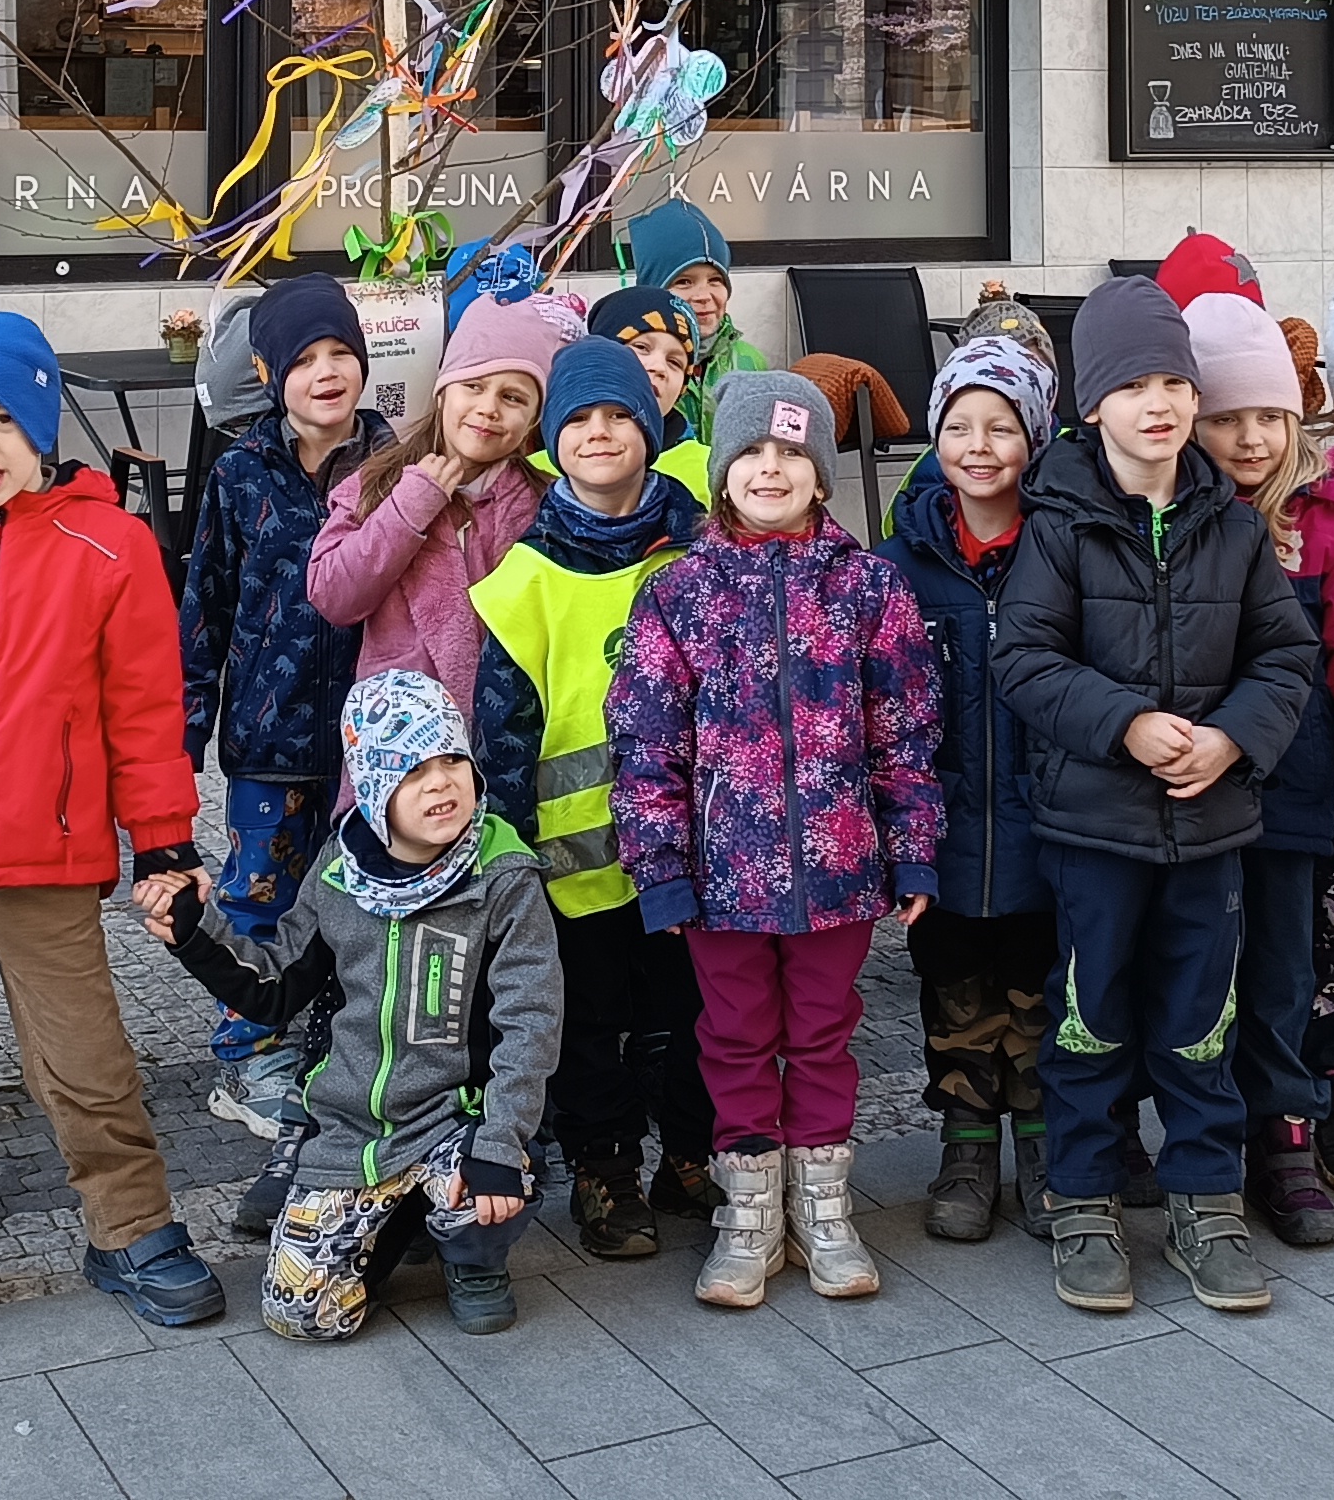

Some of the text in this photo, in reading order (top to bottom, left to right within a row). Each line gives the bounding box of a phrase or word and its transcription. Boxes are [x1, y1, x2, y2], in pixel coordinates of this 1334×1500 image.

[1155, 4, 1189, 25] YUZU
[1194, 5, 1219, 21] TEA
[1168, 41, 1203, 60] DNES
[1209, 41, 1226, 58] NA
[1224, 61, 1293, 80] GUATEMALA
[1221, 81, 1287, 100] ETHIOPIA
[1174, 101, 1299, 122] ZAHRÁDKA BEZ
[669, 161, 931, 204] KAVÁRNA
[376, 316, 420, 334] KLÍČEK
